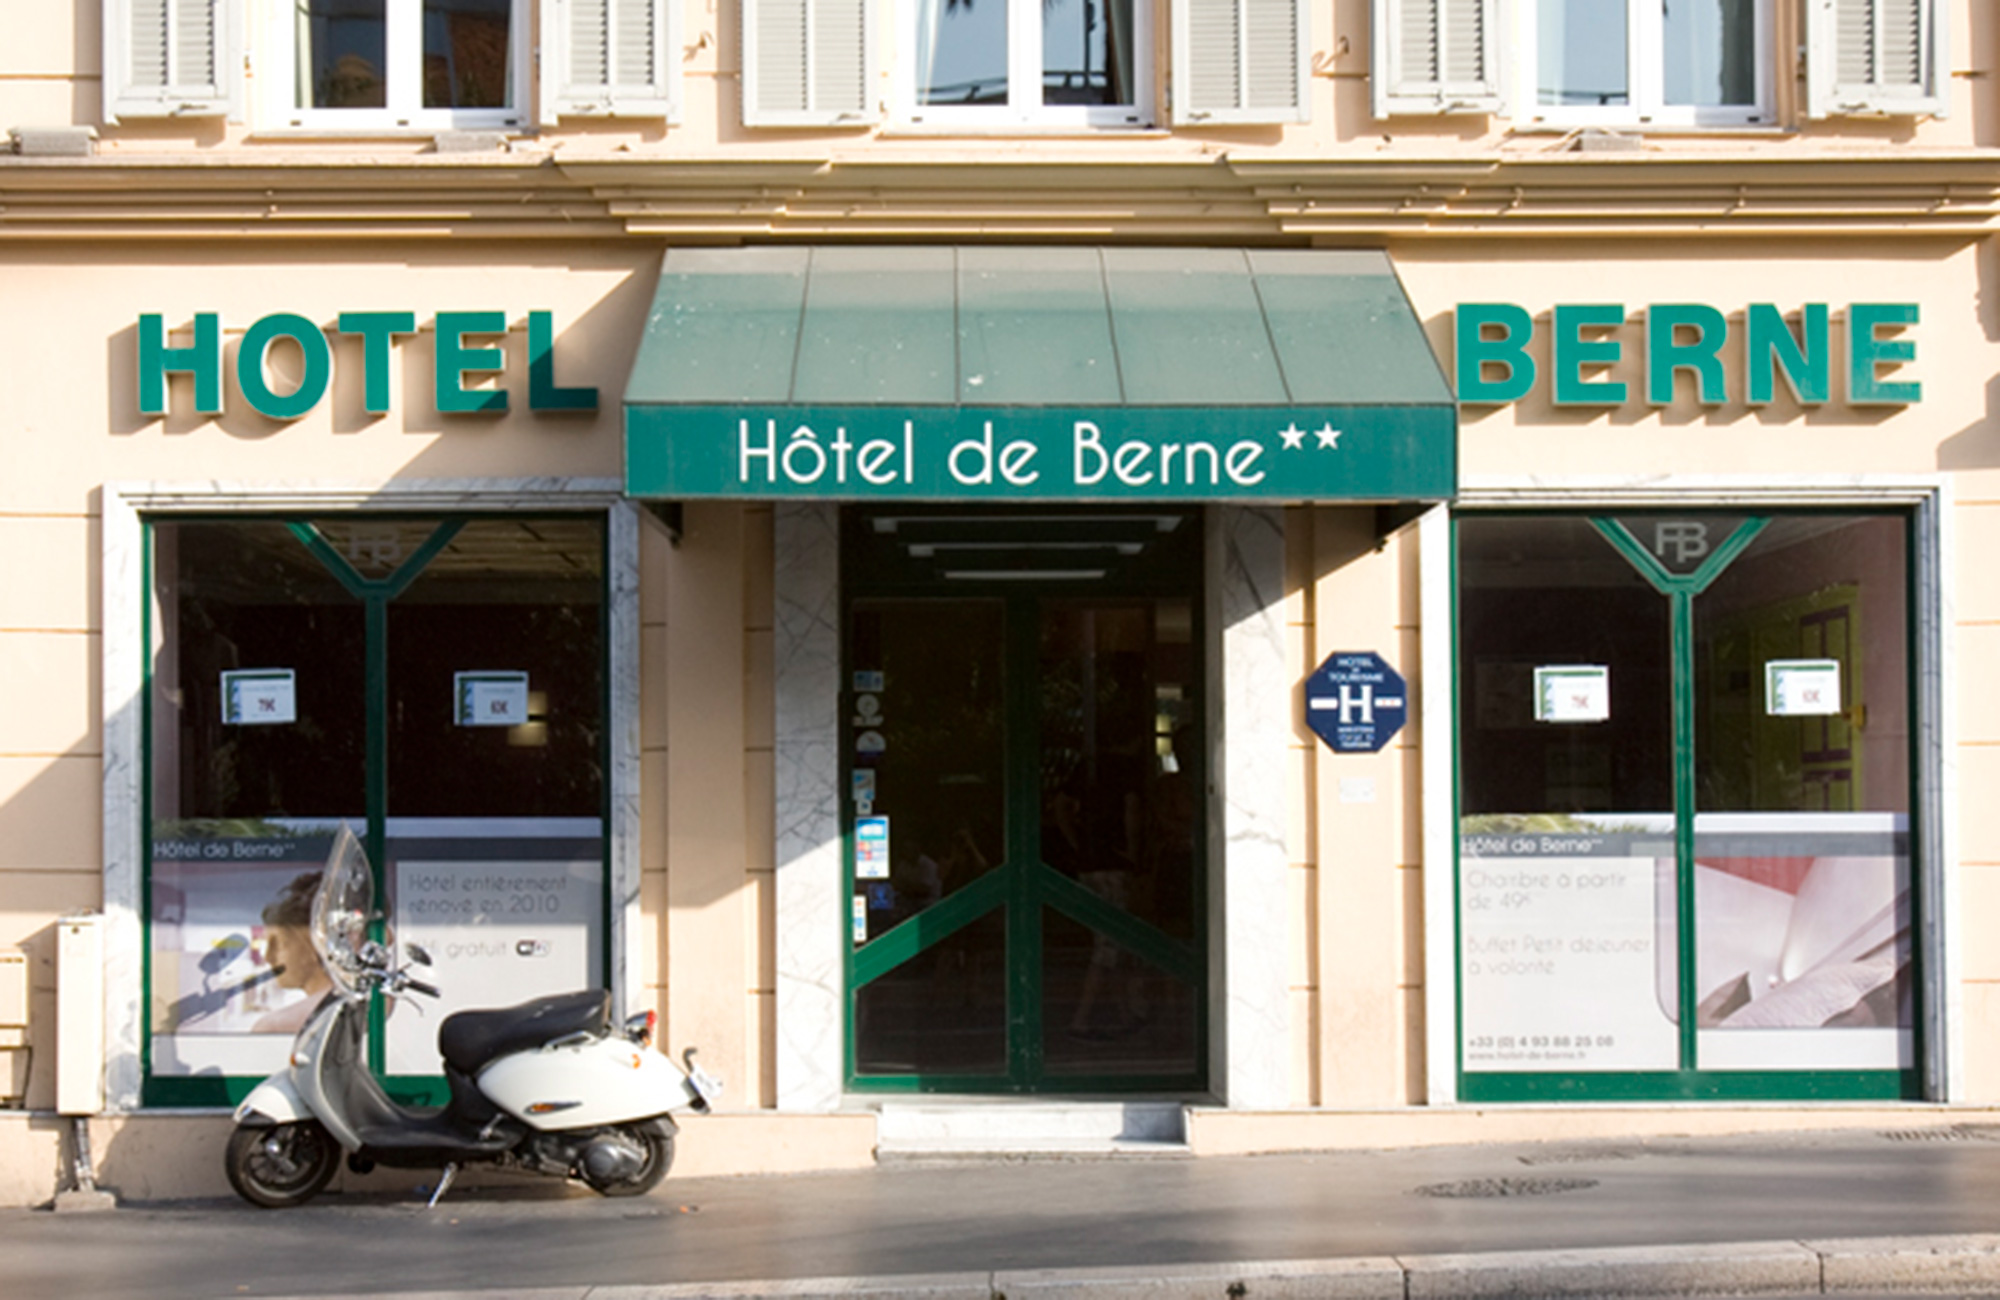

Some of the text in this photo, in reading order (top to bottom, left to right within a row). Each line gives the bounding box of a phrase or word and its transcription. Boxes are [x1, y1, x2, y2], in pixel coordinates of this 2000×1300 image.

[1456, 303, 1922, 404] BERNE
[138, 310, 599, 419] HOTEL
[739, 419, 1267, 486] Hôtel de Berne
[1338, 684, 1374, 724] H
[153, 839, 200, 858] Hôtel
[203, 840, 229, 858] de
[1511, 837, 1537, 854] de
[408, 872, 457, 893] Hôtel
[1466, 869, 1551, 890] Chambre
[1576, 871, 1627, 891] partir
[480, 898, 503, 914] en
[509, 893, 561, 914] 2010
[1466, 893, 1492, 911] de
[446, 937, 508, 960] gratuit
[1467, 933, 1518, 954] Buffet
[1523, 933, 1563, 954] Petit
[1519, 1035, 1529, 1048] 4
